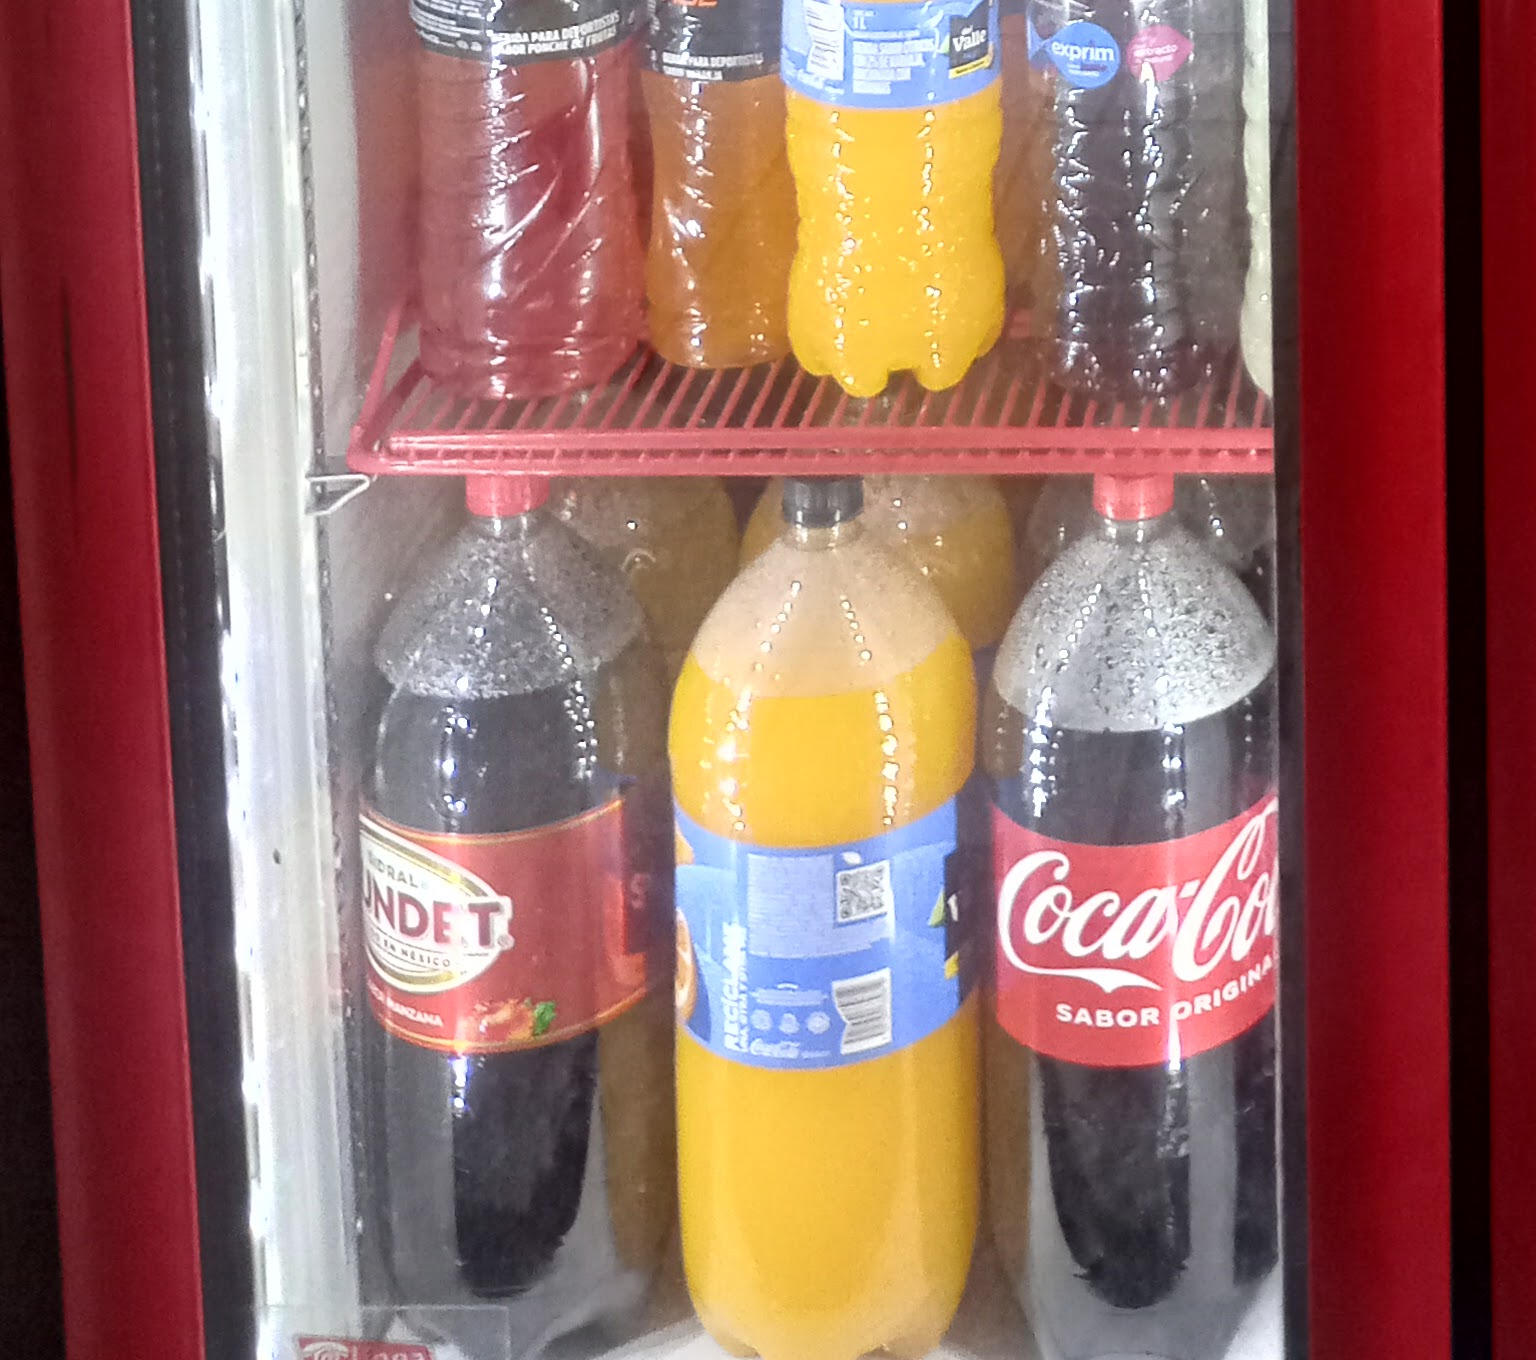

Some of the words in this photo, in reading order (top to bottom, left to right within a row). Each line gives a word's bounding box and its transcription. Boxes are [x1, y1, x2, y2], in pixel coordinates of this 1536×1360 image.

[531, 29, 561, 42] PARA
[952, 29, 987, 53] Valle
[1051, 40, 1116, 62] exprim
[368, 850, 419, 889] IDRAL
[400, 946, 451, 968] MÉXICO
[1055, 1003, 1161, 1028] SABOR
[1171, 953, 1275, 1022] ORIGINA
[386, 997, 444, 1027] MANZANA
